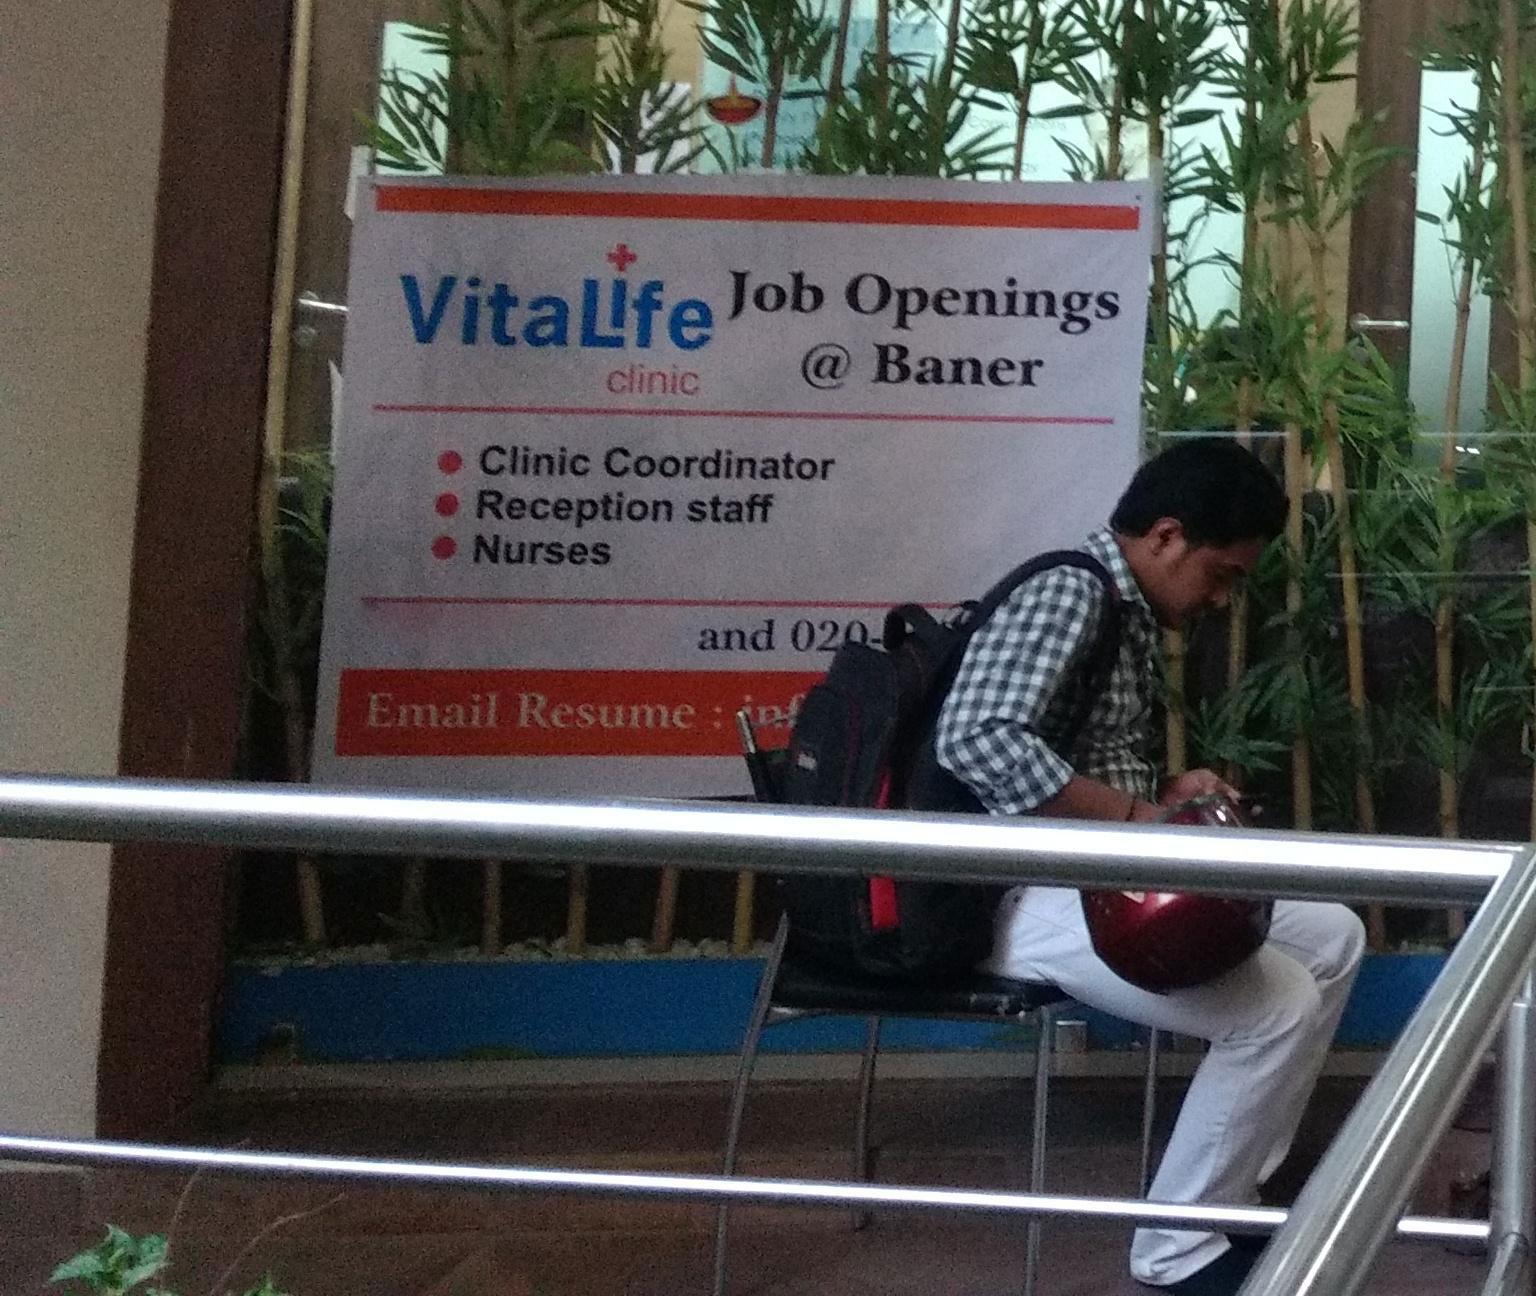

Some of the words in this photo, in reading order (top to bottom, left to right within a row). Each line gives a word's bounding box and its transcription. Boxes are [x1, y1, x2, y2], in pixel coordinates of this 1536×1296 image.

[401, 274, 713, 351] VitaLife
[728, 269, 824, 322] Job
[845, 272, 1121, 337] Openings
[606, 364, 700, 397] clinic
[801, 342, 851, 391] @
[872, 343, 1044, 389] Baner
[479, 444, 590, 479] Clinic
[605, 447, 836, 482] Coordinator
[476, 490, 680, 530] Reception
[687, 494, 774, 525] staff
[474, 534, 611, 567] Nurses
[698, 619, 775, 652] and
[368, 691, 498, 732] Email
[518, 693, 695, 731] Resume
